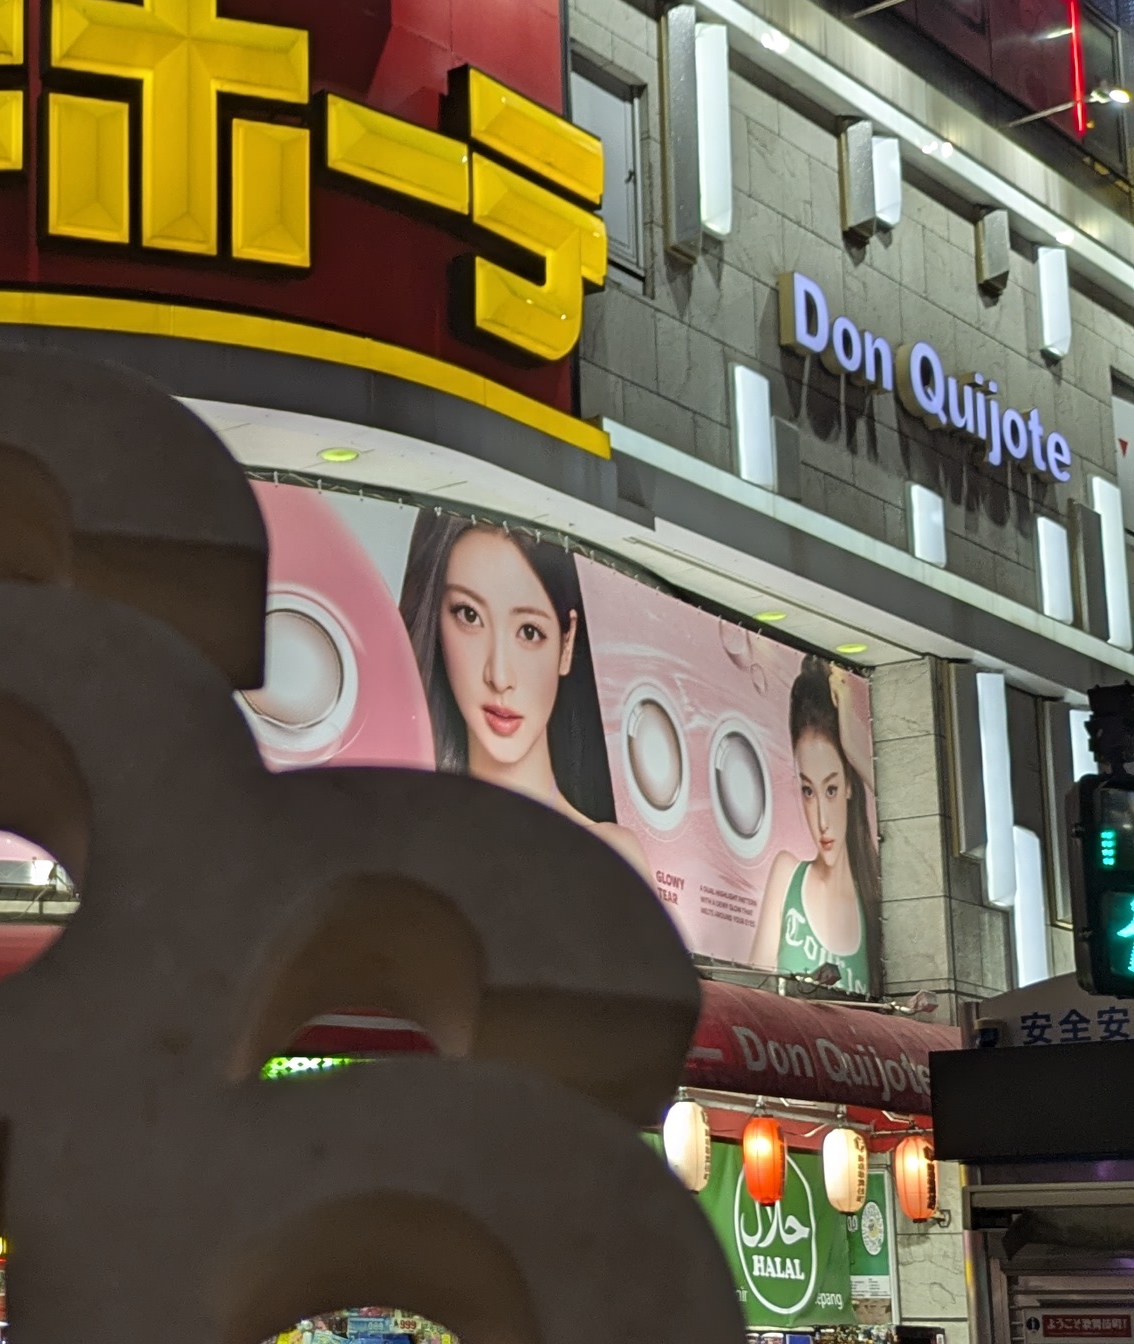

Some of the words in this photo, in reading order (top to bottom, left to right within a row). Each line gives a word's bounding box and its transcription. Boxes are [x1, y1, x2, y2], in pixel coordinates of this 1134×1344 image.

[793, 271, 893, 392] Don
[909, 340, 1072, 483] Quijote
[655, 870, 685, 891] GLOWY
[657, 887, 679, 905] TEAR
[732, 1025, 814, 1078] Don
[816, 1038, 931, 1102] Quijote
[752, 1254, 806, 1280] HALAL
[815, 1292, 843, 1310] epang
